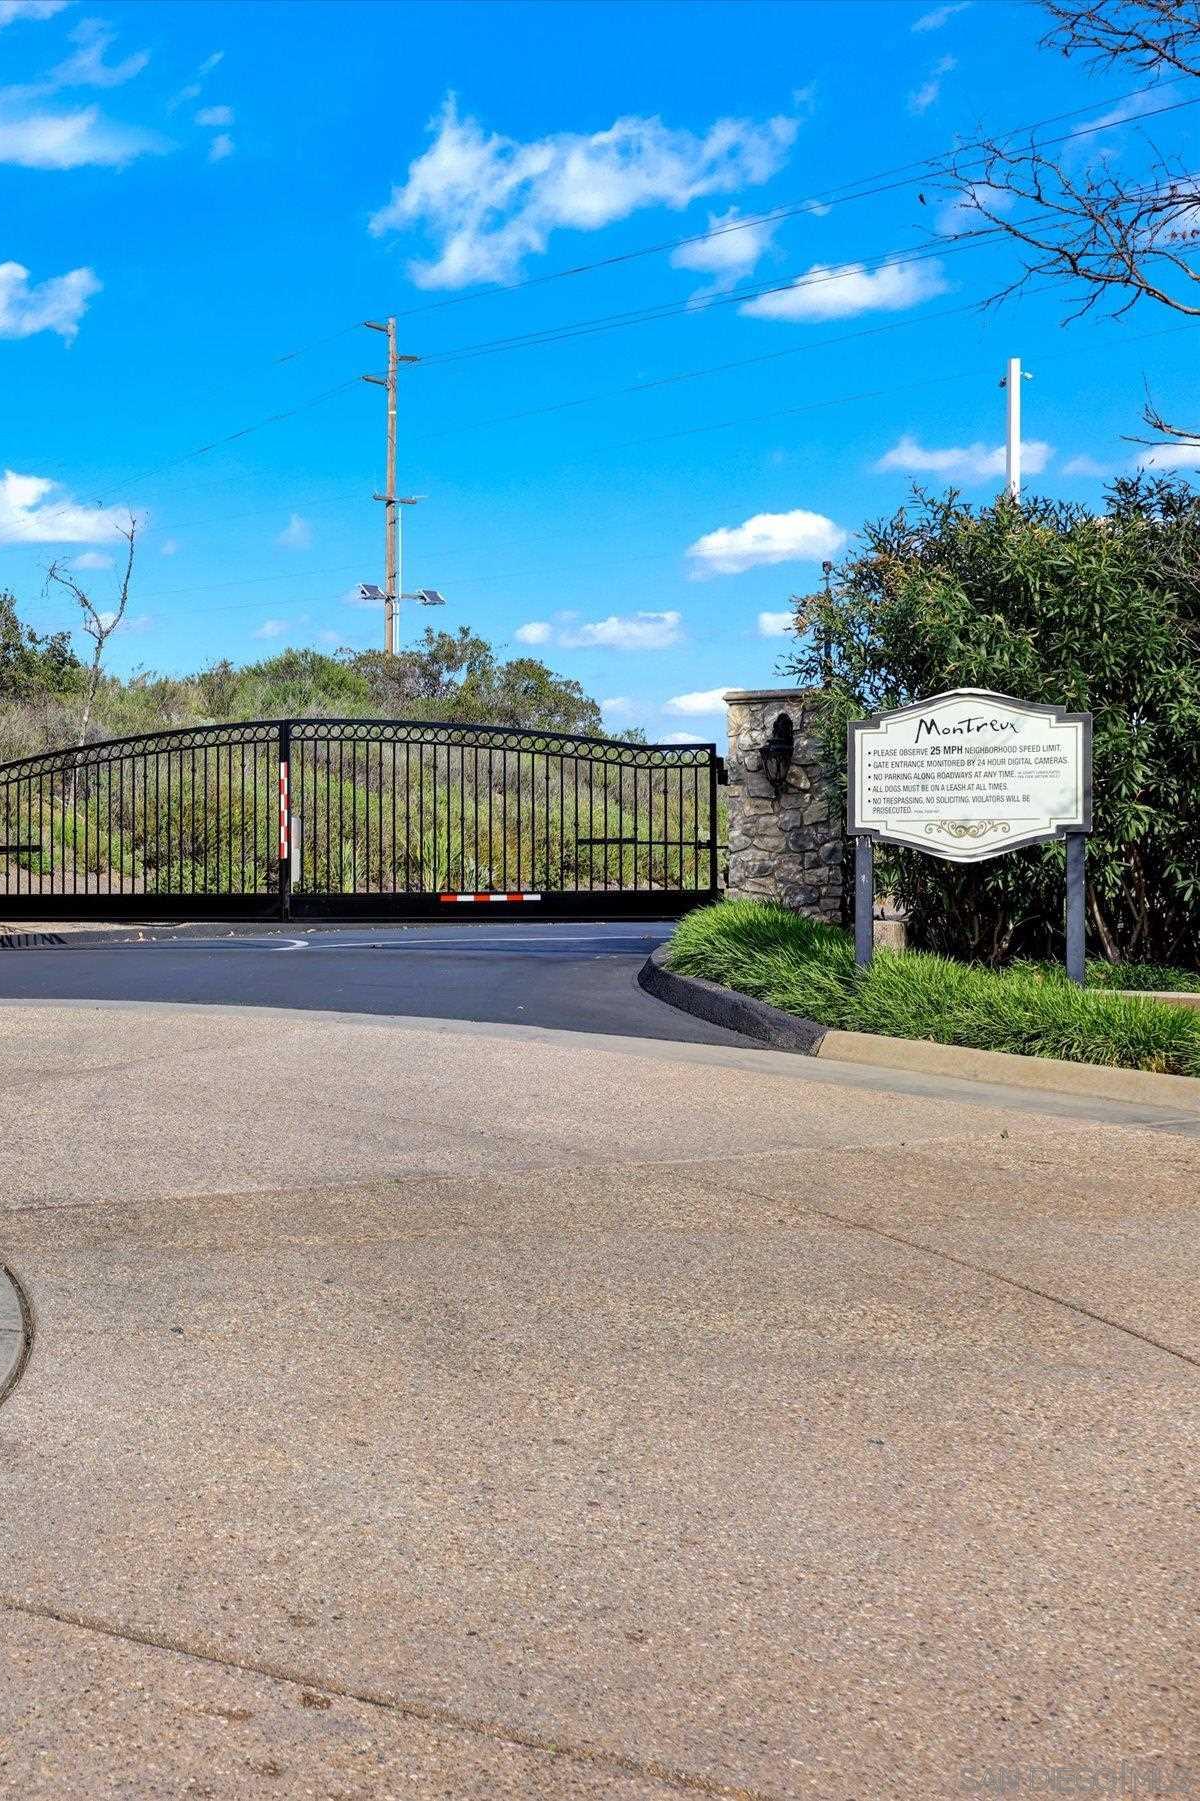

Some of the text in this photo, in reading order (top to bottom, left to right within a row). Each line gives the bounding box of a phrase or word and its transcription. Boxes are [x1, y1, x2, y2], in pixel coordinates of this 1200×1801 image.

[914, 717, 1019, 744] Montreux
[930, 746, 941, 755] 25
[944, 746, 963, 754] MPH
[965, 745, 1017, 754] NEIGHBORHOOD
